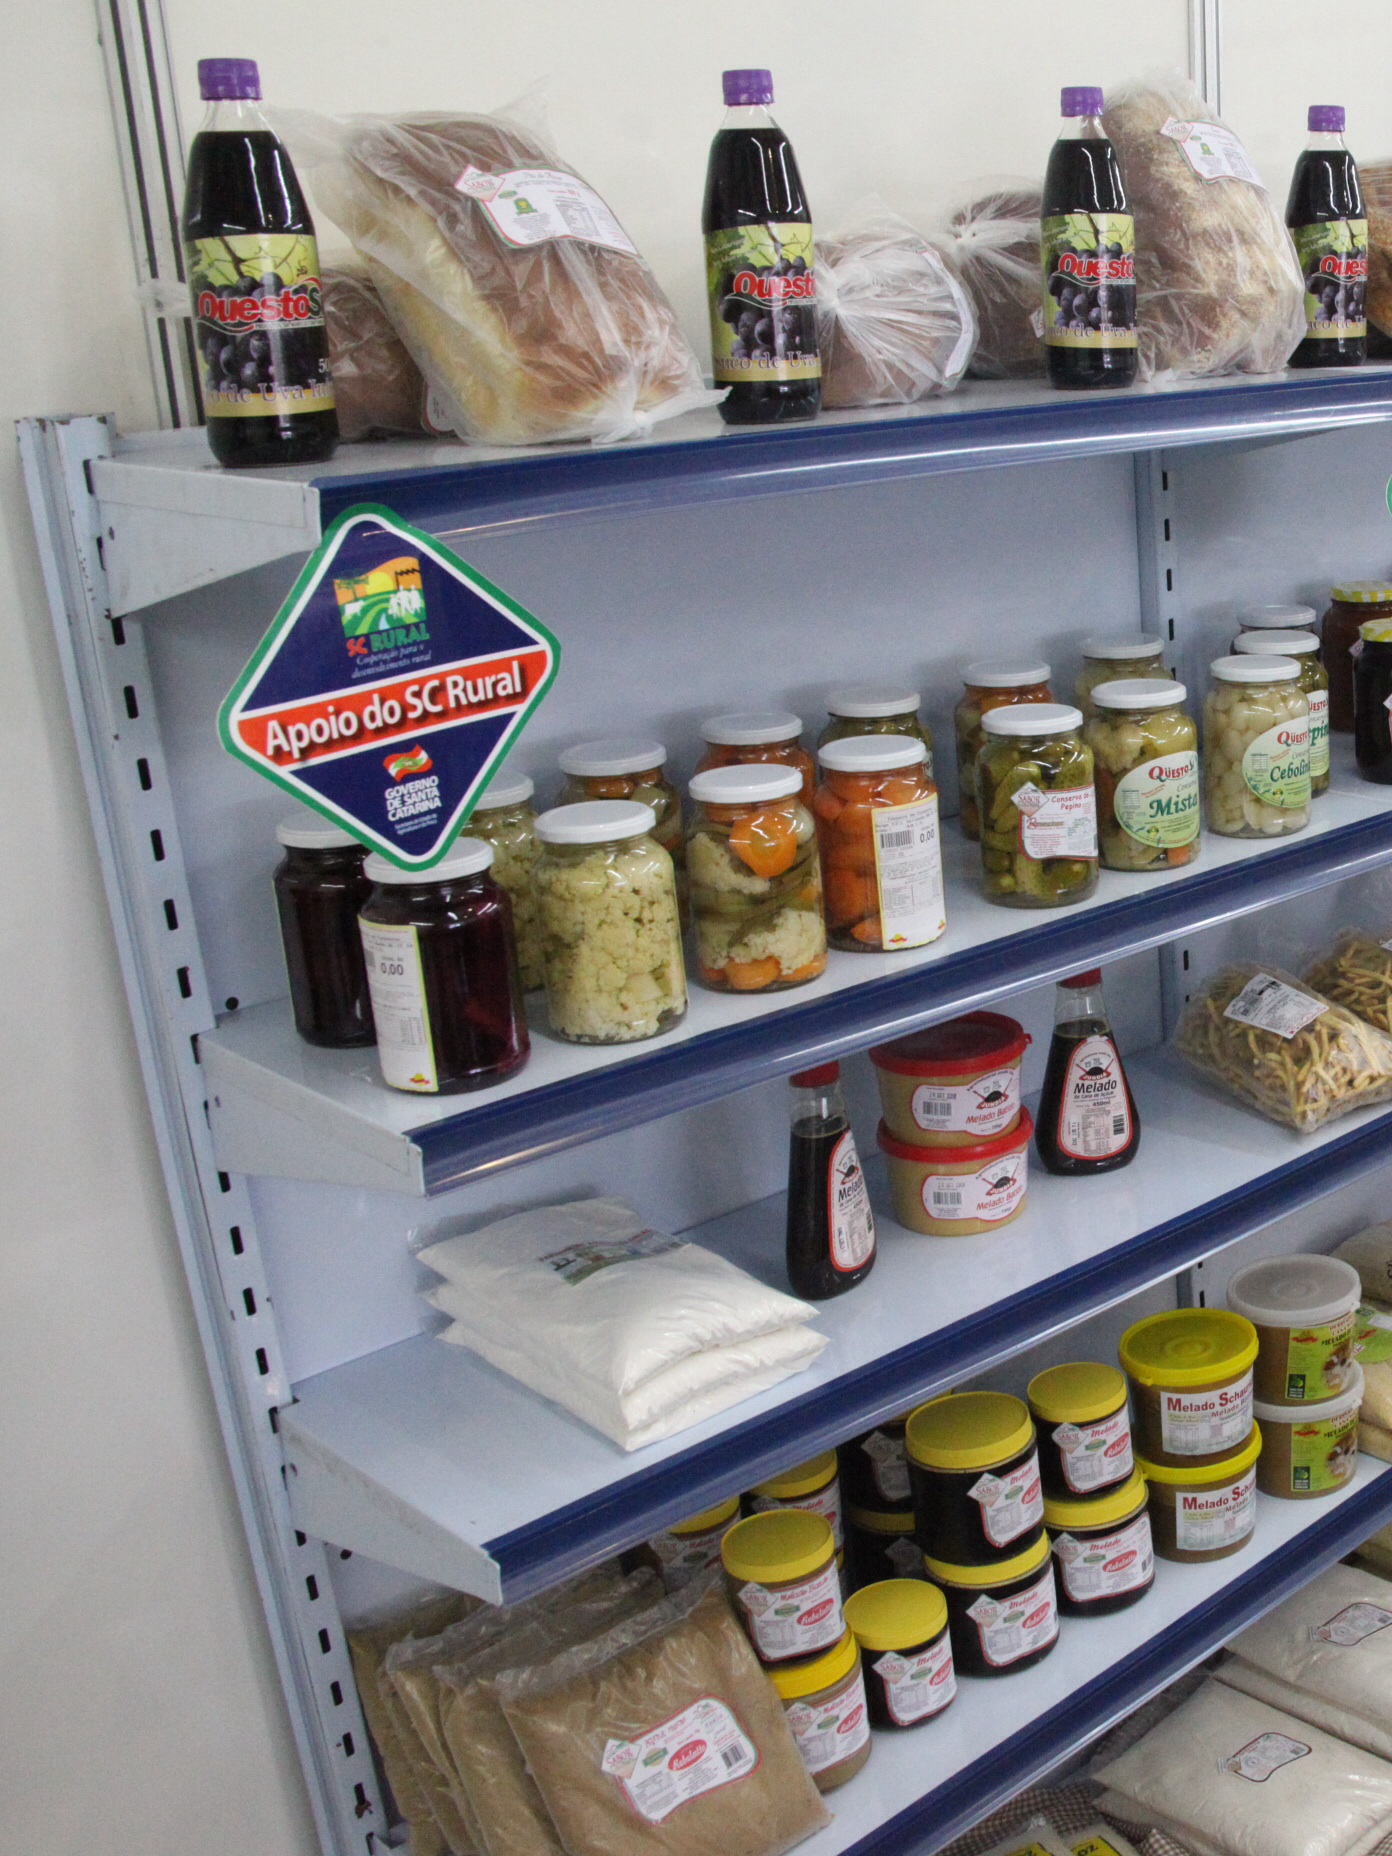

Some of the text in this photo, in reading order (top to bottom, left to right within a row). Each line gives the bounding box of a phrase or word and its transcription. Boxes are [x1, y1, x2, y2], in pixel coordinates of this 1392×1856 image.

[1318, 254, 1368, 275] Ques
[758, 352, 783, 369] de
[226, 383, 251, 403] de
[258, 381, 304, 402] Uva
[346, 622, 431, 657] SC RURAL
[265, 660, 523, 760] Apoio do SC Rural
[1148, 763, 1188, 783] QÜESTO
[384, 775, 439, 799] GOVERNO
[386, 786, 440, 811] DE SANTA
[1051, 794, 1082, 803] Conserva
[1060, 802, 1082, 811] Pepino
[1149, 792, 1198, 819] Mista
[387, 796, 443, 822] CATARINA
[380, 962, 404, 977] 0,00
[1074, 1079, 1117, 1095] Melado
[966, 1111, 996, 1125] Melado
[976, 1197, 1005, 1211] Melado
[1167, 1396, 1216, 1413] Melado
[1057, 1432, 1080, 1441] SABOR
[977, 1482, 1000, 1496] SABOR
[1182, 1496, 1229, 1511] Melado
[974, 1604, 998, 1619] SABOR
[879, 1660, 906, 1674] SABOR
[605, 1747, 634, 1765] SABOR
[672, 1743, 707, 1771] Rebelatto
